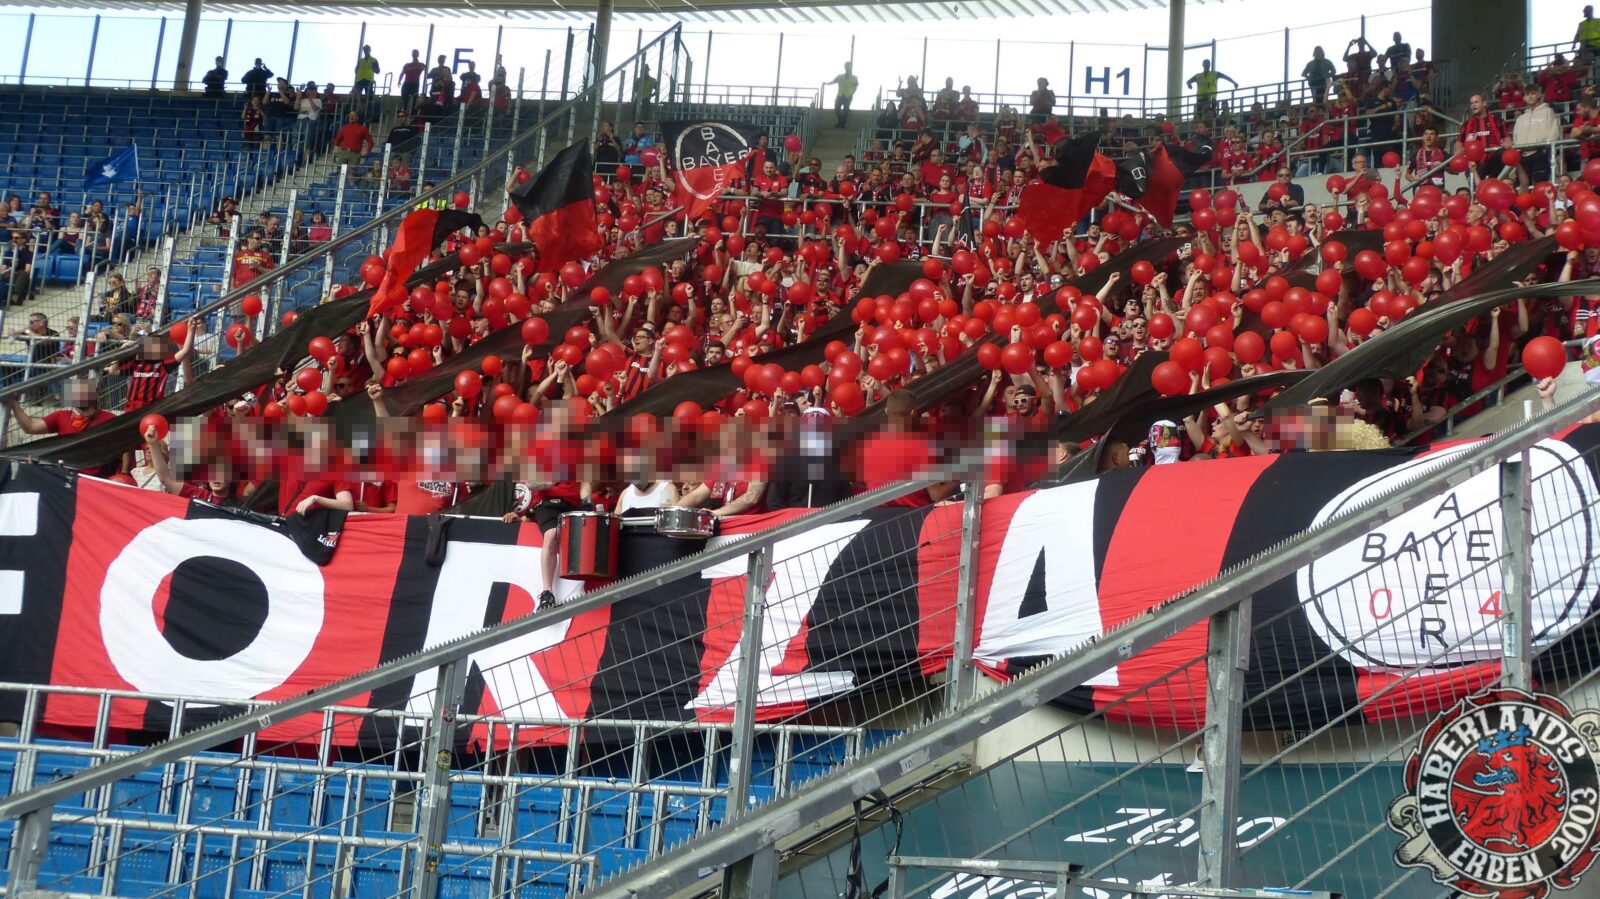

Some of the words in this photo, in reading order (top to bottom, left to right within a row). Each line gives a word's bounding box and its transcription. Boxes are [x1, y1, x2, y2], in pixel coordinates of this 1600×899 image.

[452, 48, 474, 74] F
[1085, 66, 1131, 95] H1
[682, 147, 752, 171] BAYER
[1362, 531, 1494, 562] BAYE
[1419, 492, 1462, 649] AYER
